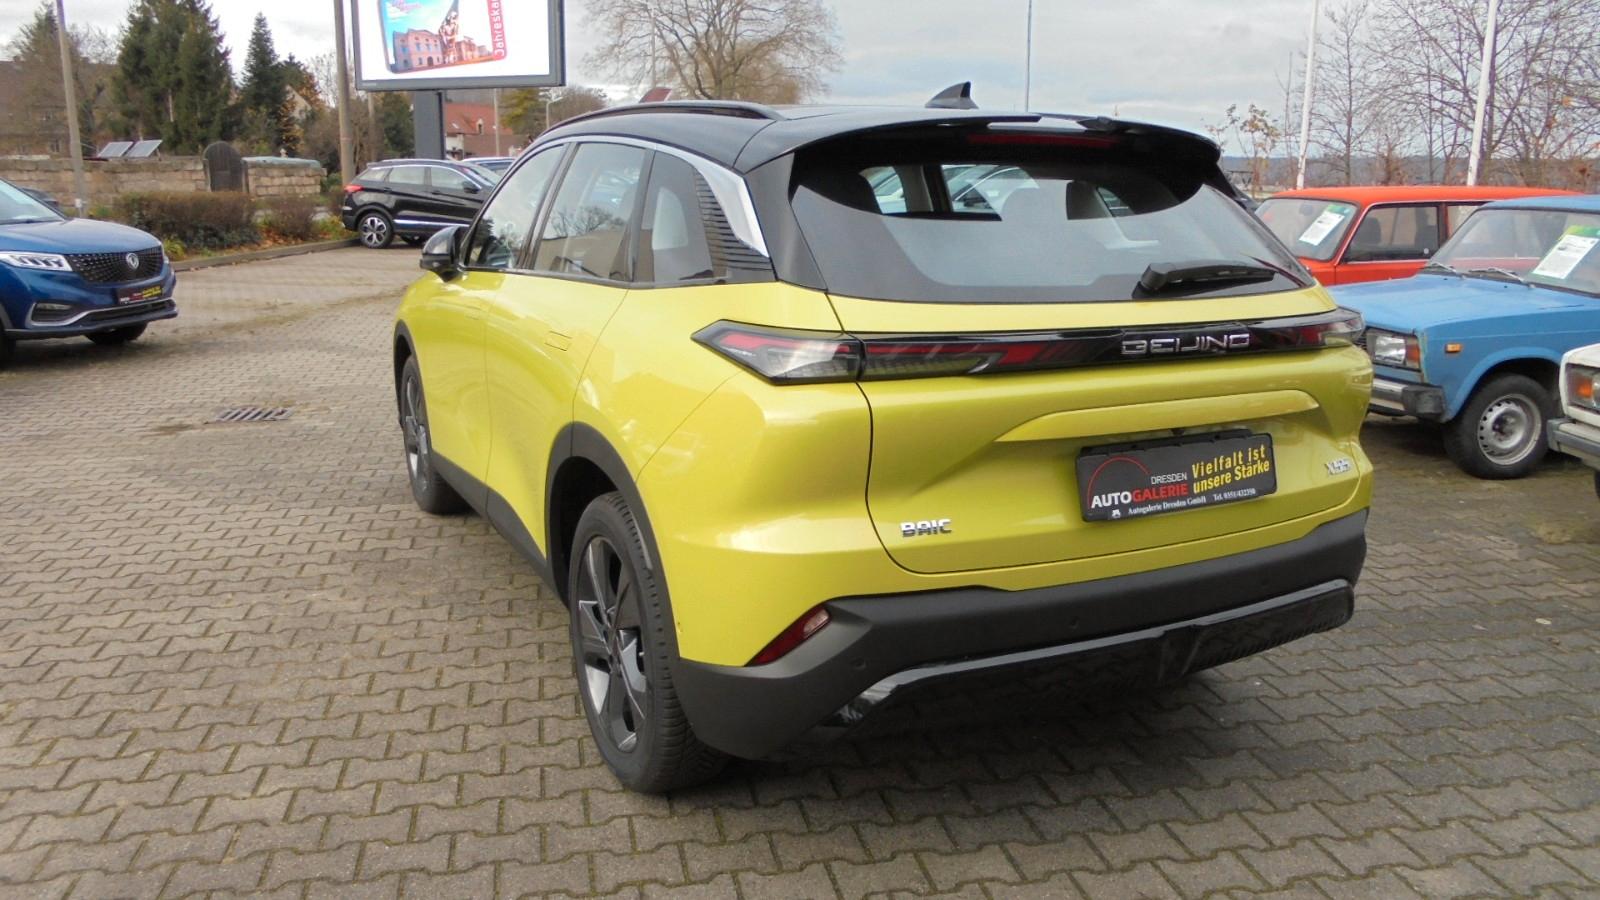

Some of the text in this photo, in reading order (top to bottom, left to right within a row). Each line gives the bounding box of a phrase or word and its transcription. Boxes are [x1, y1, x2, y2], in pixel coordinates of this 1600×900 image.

[490, 0, 504, 57] Jahreska
[1121, 333, 1250, 355] BEIJING
[1192, 444, 1265, 479] Vielfalt ist
[1151, 472, 1188, 485] DRESDEN
[1193, 460, 1270, 494] unsere Stärke
[1162, 498, 1187, 510] Dresden
[1186, 495, 1207, 506] GmbH
[900, 518, 952, 537] BAIC
